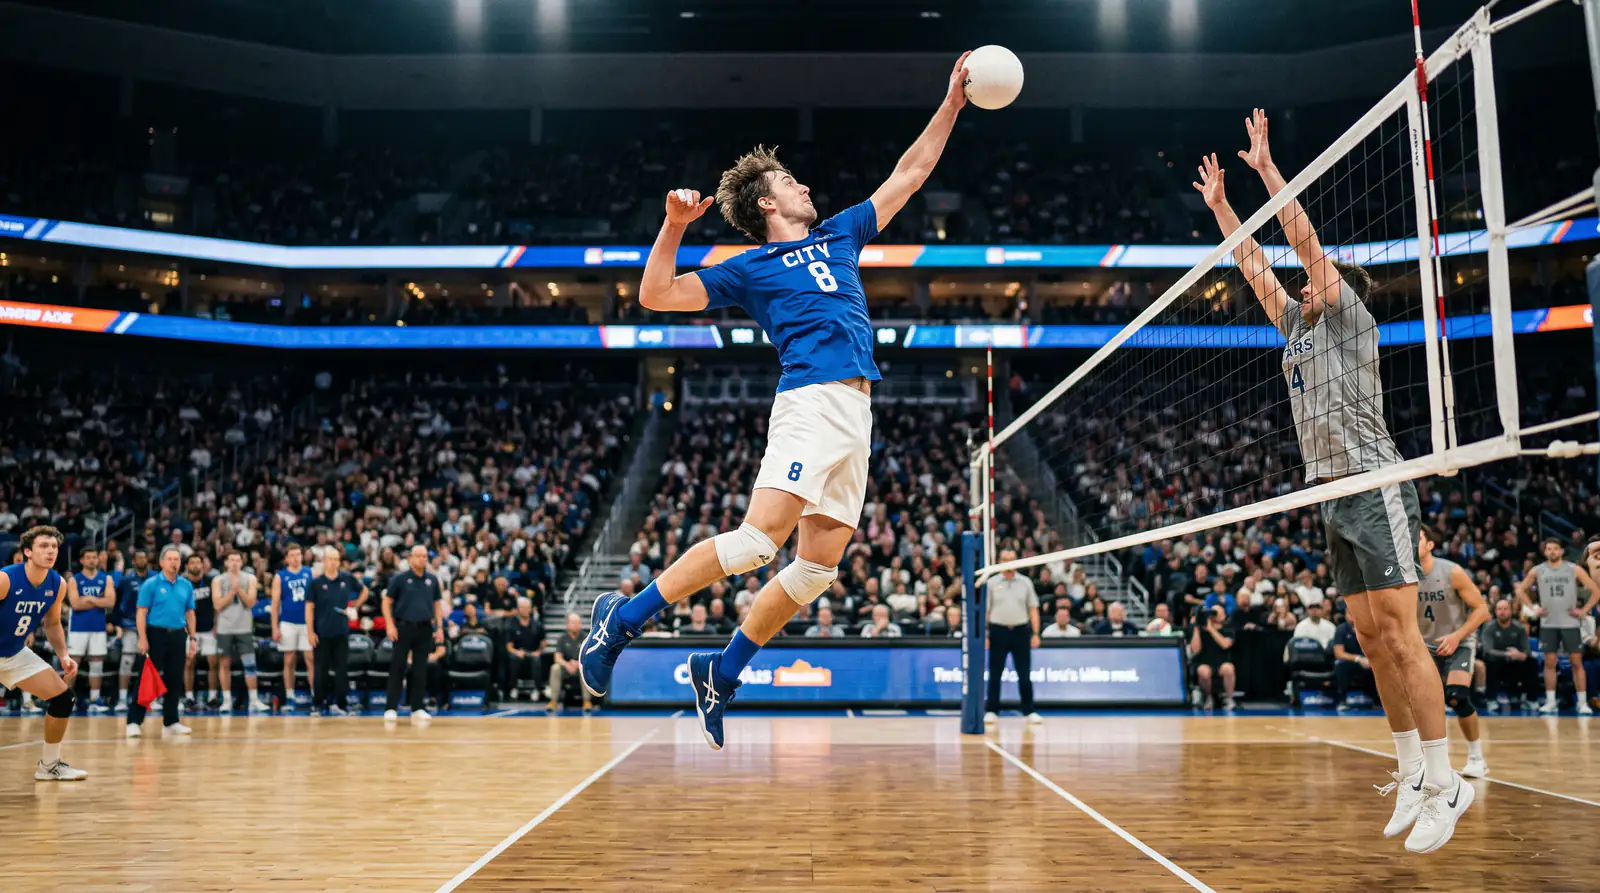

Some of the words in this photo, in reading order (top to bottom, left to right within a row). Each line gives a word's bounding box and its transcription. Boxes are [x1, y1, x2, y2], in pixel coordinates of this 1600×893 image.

[782, 242, 831, 268] CITY
[808, 261, 839, 292] 8
[1291, 364, 1305, 393] 4
[788, 461, 803, 482] 8
[15, 601, 46, 614] CITY
[1424, 605, 1436, 622] 4
[14, 615, 32, 637] 8
